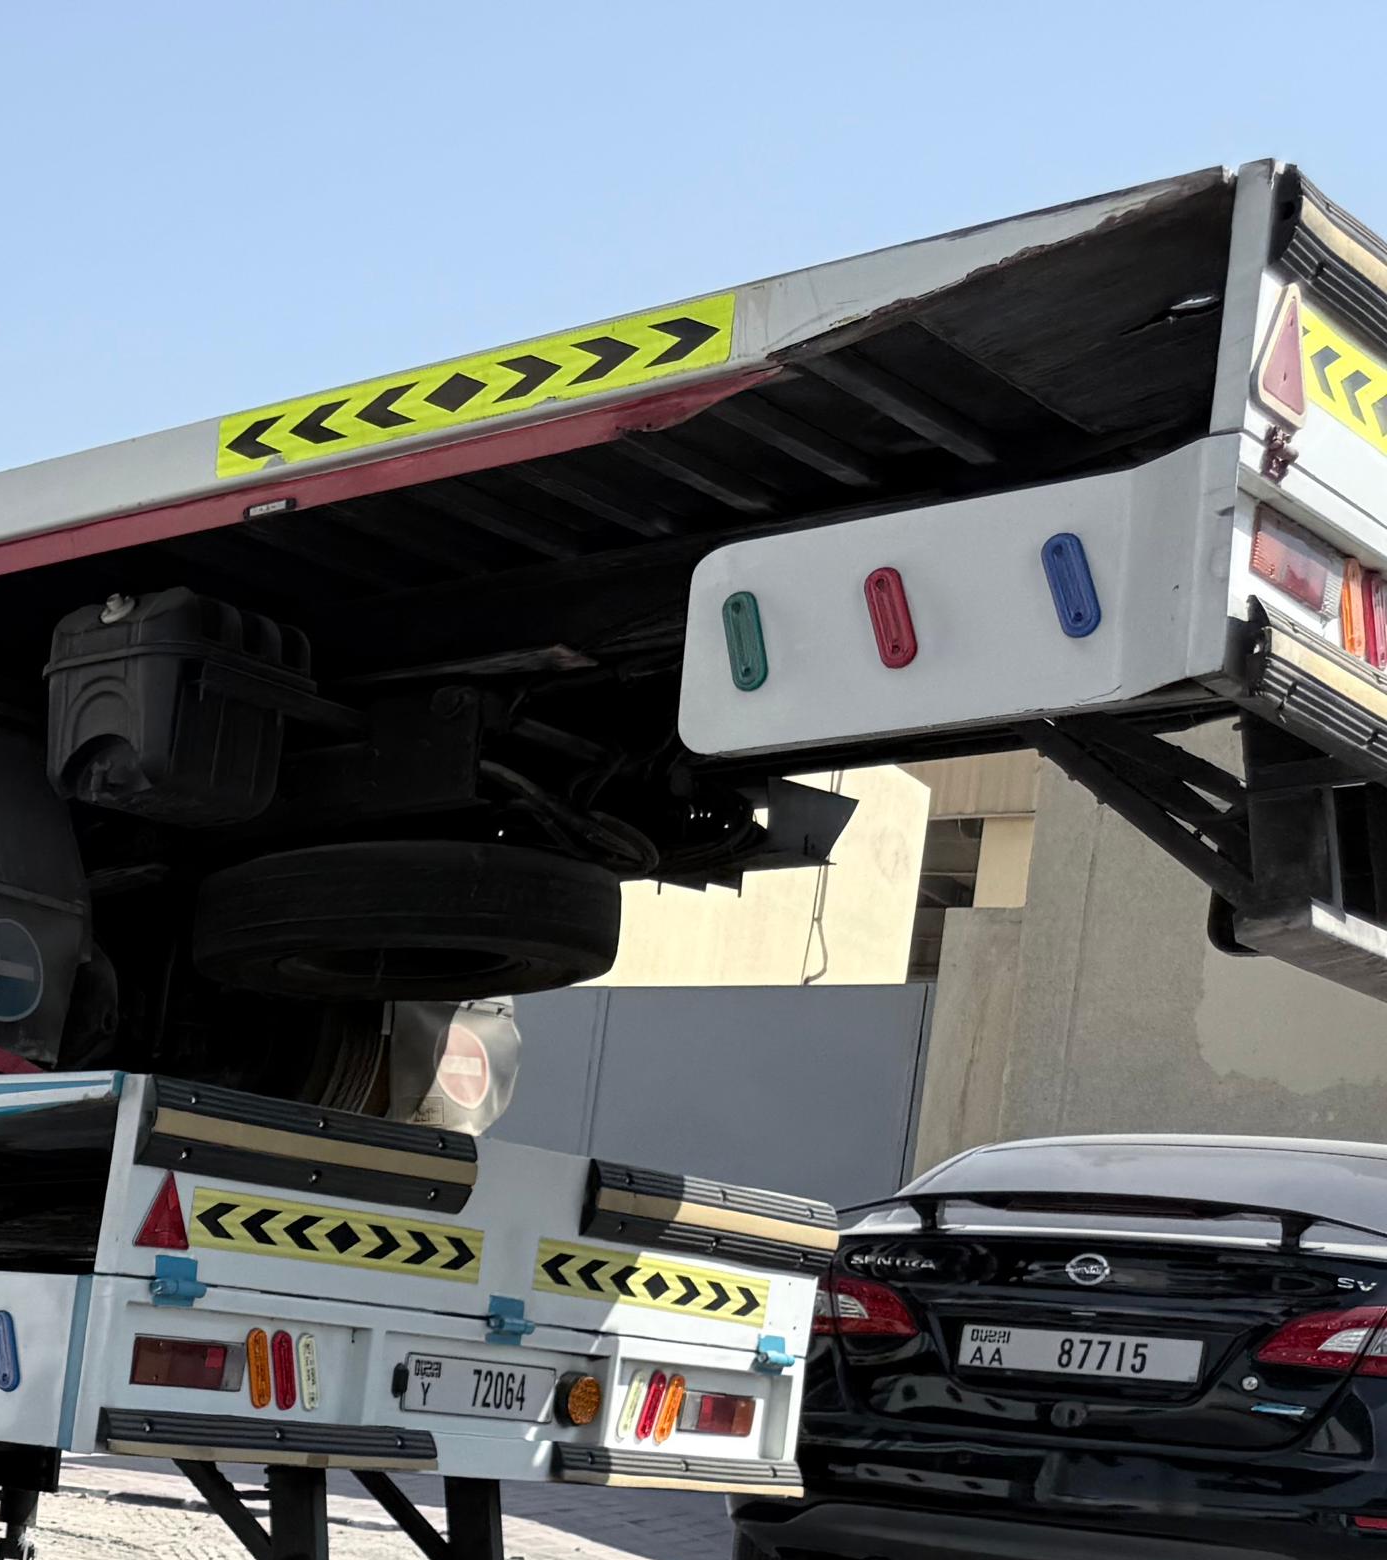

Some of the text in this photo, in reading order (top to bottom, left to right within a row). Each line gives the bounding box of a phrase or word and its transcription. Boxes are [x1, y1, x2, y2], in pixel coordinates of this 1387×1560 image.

[1337, 1277, 1377, 1292] SV
[970, 1328, 1011, 1344] DUBAI
[1057, 1337, 1148, 1374] 87715
[421, 1368, 526, 1411] Y 72064
